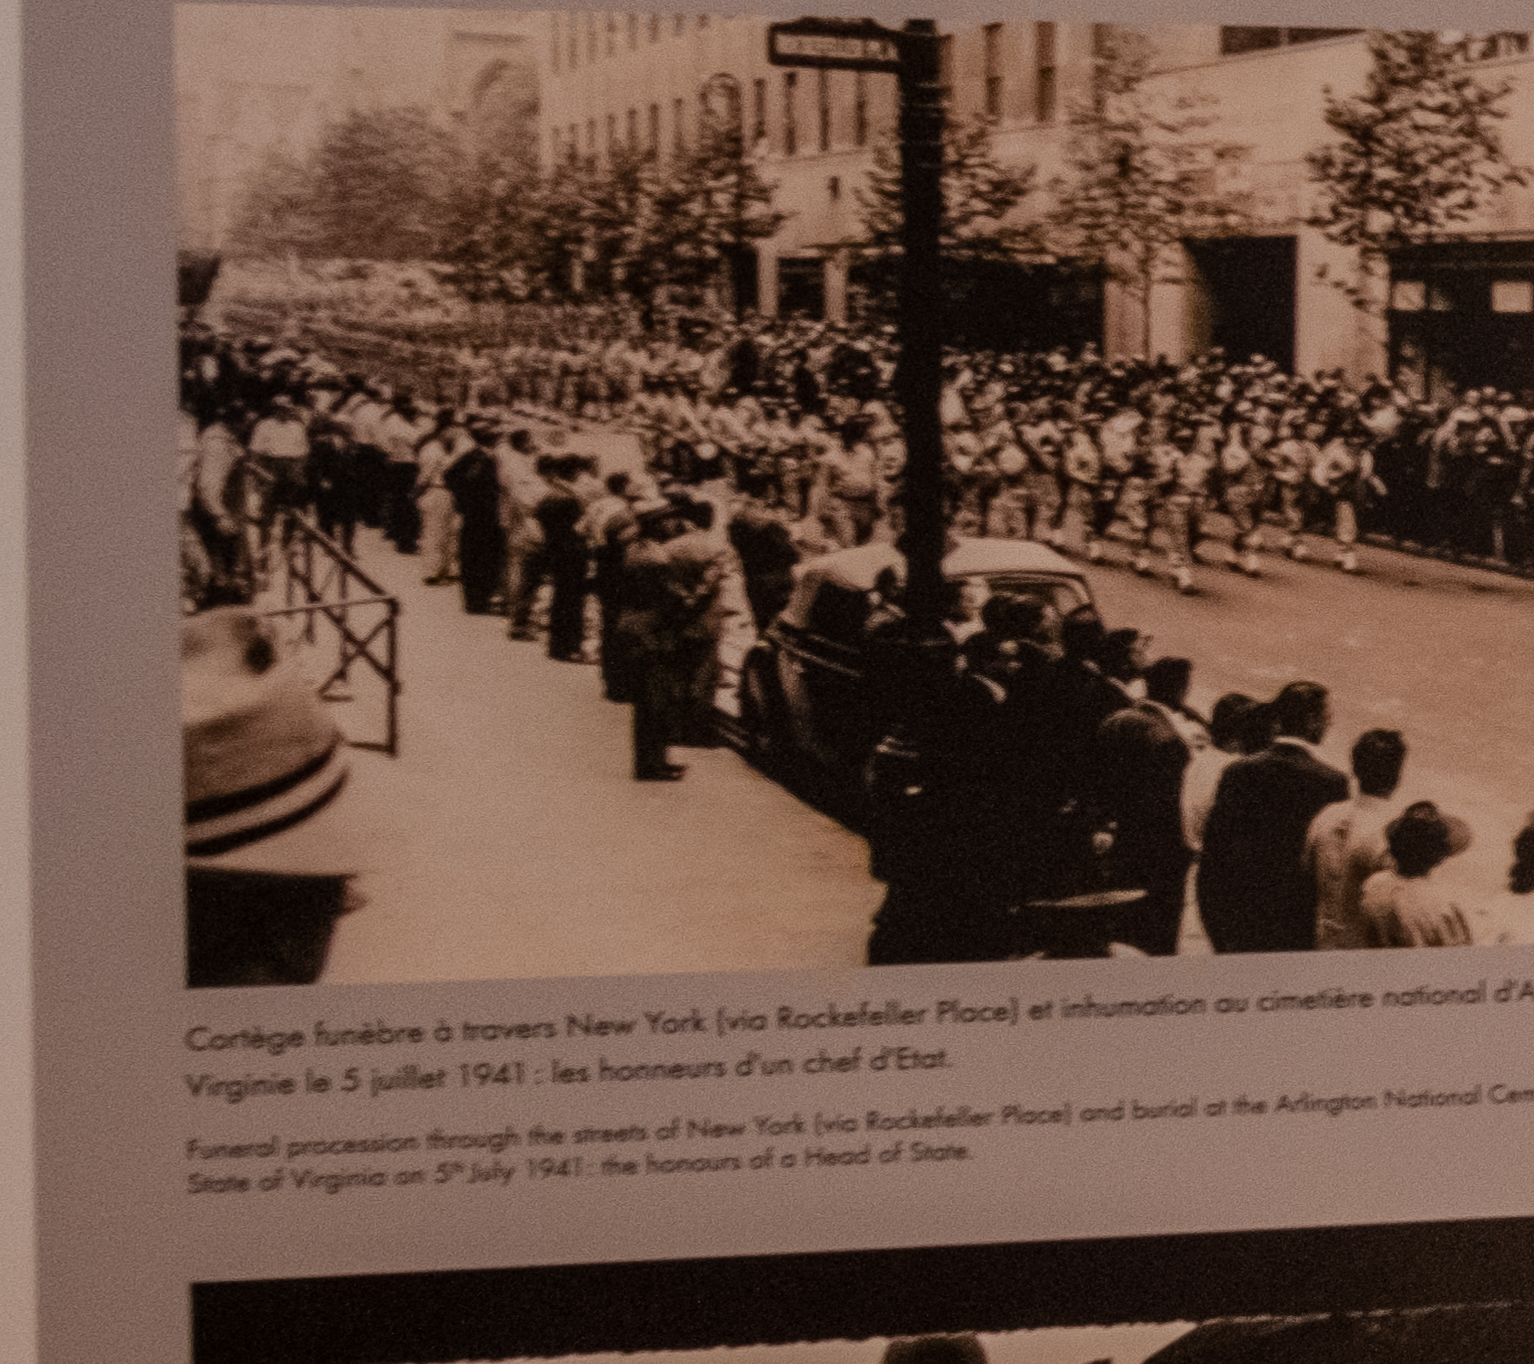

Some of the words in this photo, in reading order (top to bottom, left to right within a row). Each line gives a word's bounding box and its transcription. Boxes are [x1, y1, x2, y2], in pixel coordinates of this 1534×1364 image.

[184, 1025, 306, 1057] Cortège
[313, 1020, 426, 1048] funèbre
[433, 1021, 454, 1044] à
[461, 1022, 558, 1042] travers
[565, 1013, 637, 1038] New
[644, 1008, 707, 1035] York
[716, 1008, 768, 1037] (via
[776, 1000, 928, 1031] Rockefeller
[936, 997, 1019, 1025] Place)
[1027, 1001, 1054, 1021] et
[1061, 994, 1207, 1019] inhumation
[1214, 996, 1249, 1015] au
[1256, 987, 1375, 1013] cimetière
[1382, 980, 1486, 1008] national
[185, 1074, 297, 1105] Virginie
[305, 1069, 332, 1094] le
[341, 1066, 361, 1093] 5
[370, 1064, 447, 1098] juillet
[459, 1061, 525, 1087] 1941
[551, 1059, 591, 1084] les
[598, 1057, 727, 1082] honneurs
[734, 1051, 794, 1078] d'un
[802, 1045, 863, 1075] chef
